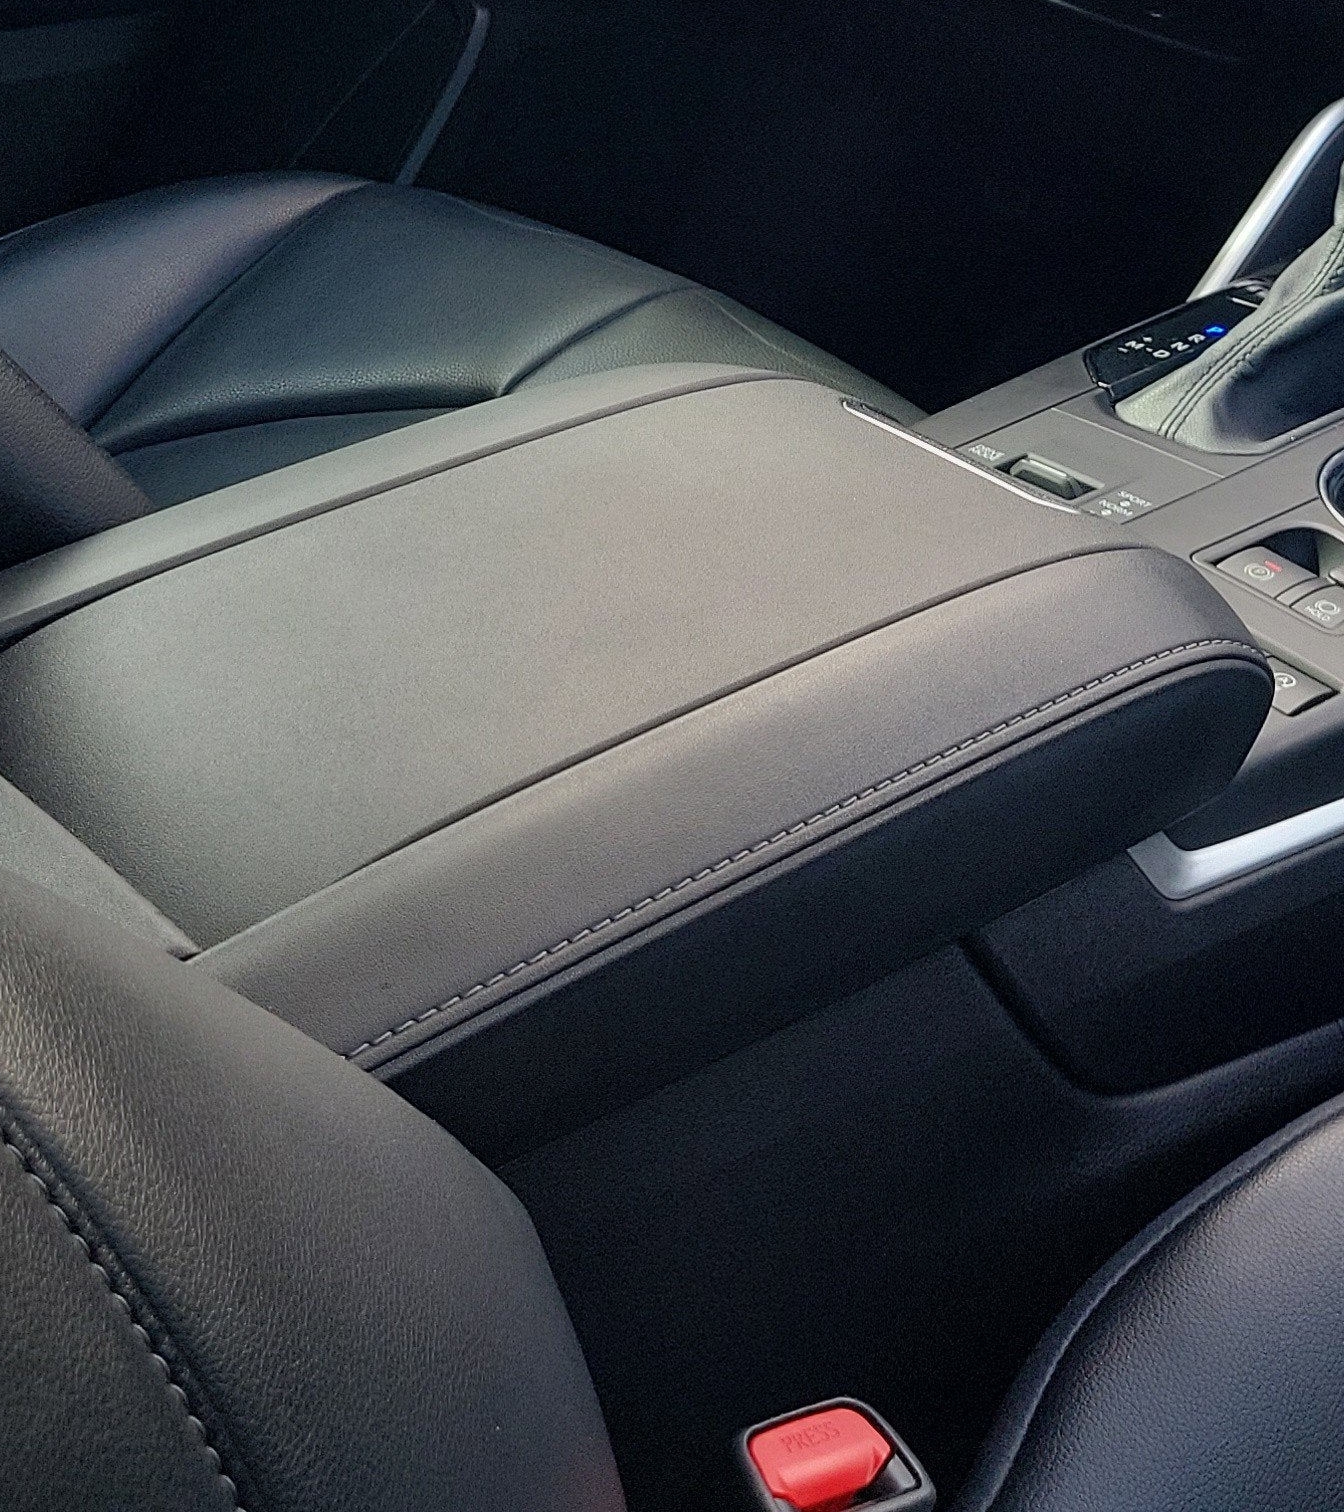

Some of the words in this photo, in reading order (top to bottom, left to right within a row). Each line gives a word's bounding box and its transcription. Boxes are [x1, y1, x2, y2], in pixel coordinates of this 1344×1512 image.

[1170, 341, 1190, 351] N
[1152, 349, 1171, 358] D
[1117, 490, 1153, 508] SPORT
[779, 1420, 841, 1454] PRESS
